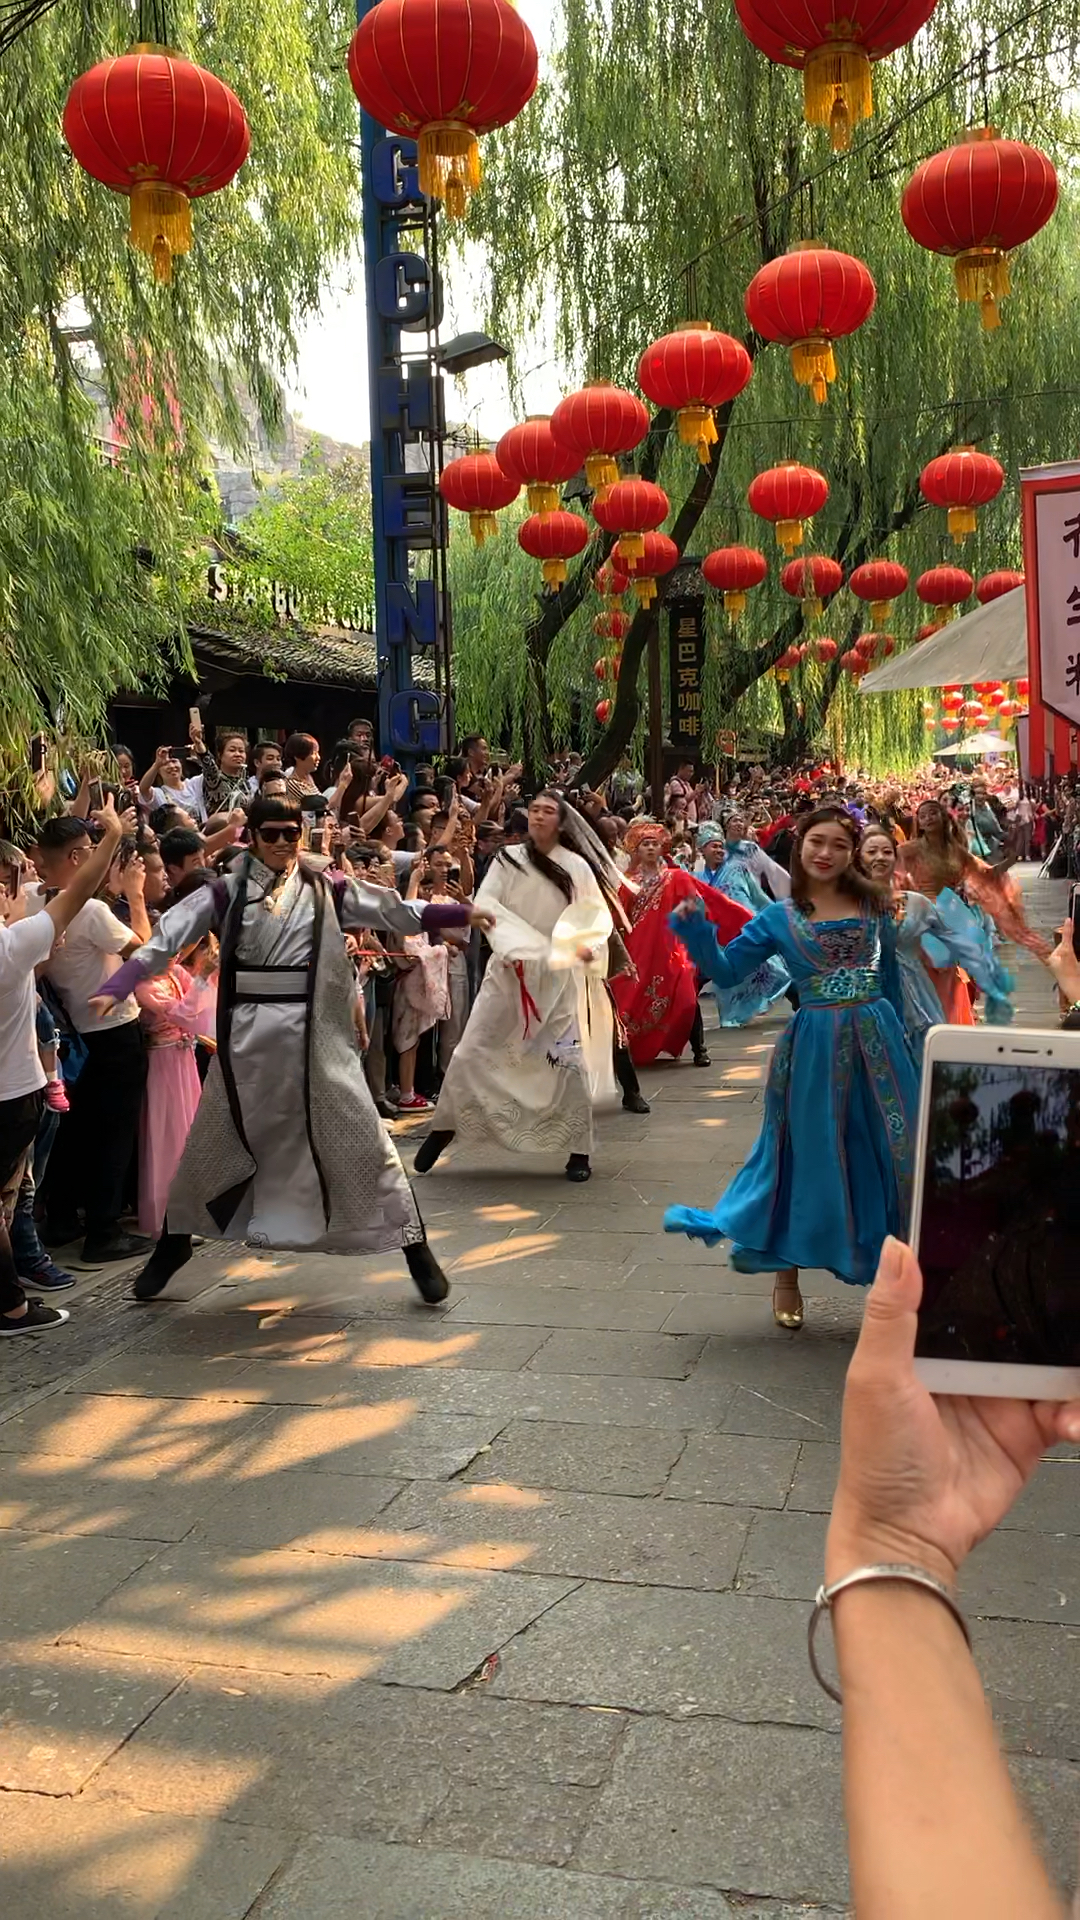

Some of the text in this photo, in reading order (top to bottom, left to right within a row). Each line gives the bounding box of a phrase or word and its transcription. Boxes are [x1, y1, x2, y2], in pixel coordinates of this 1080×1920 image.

[677, 617, 701, 737] 星巴克咖啡
